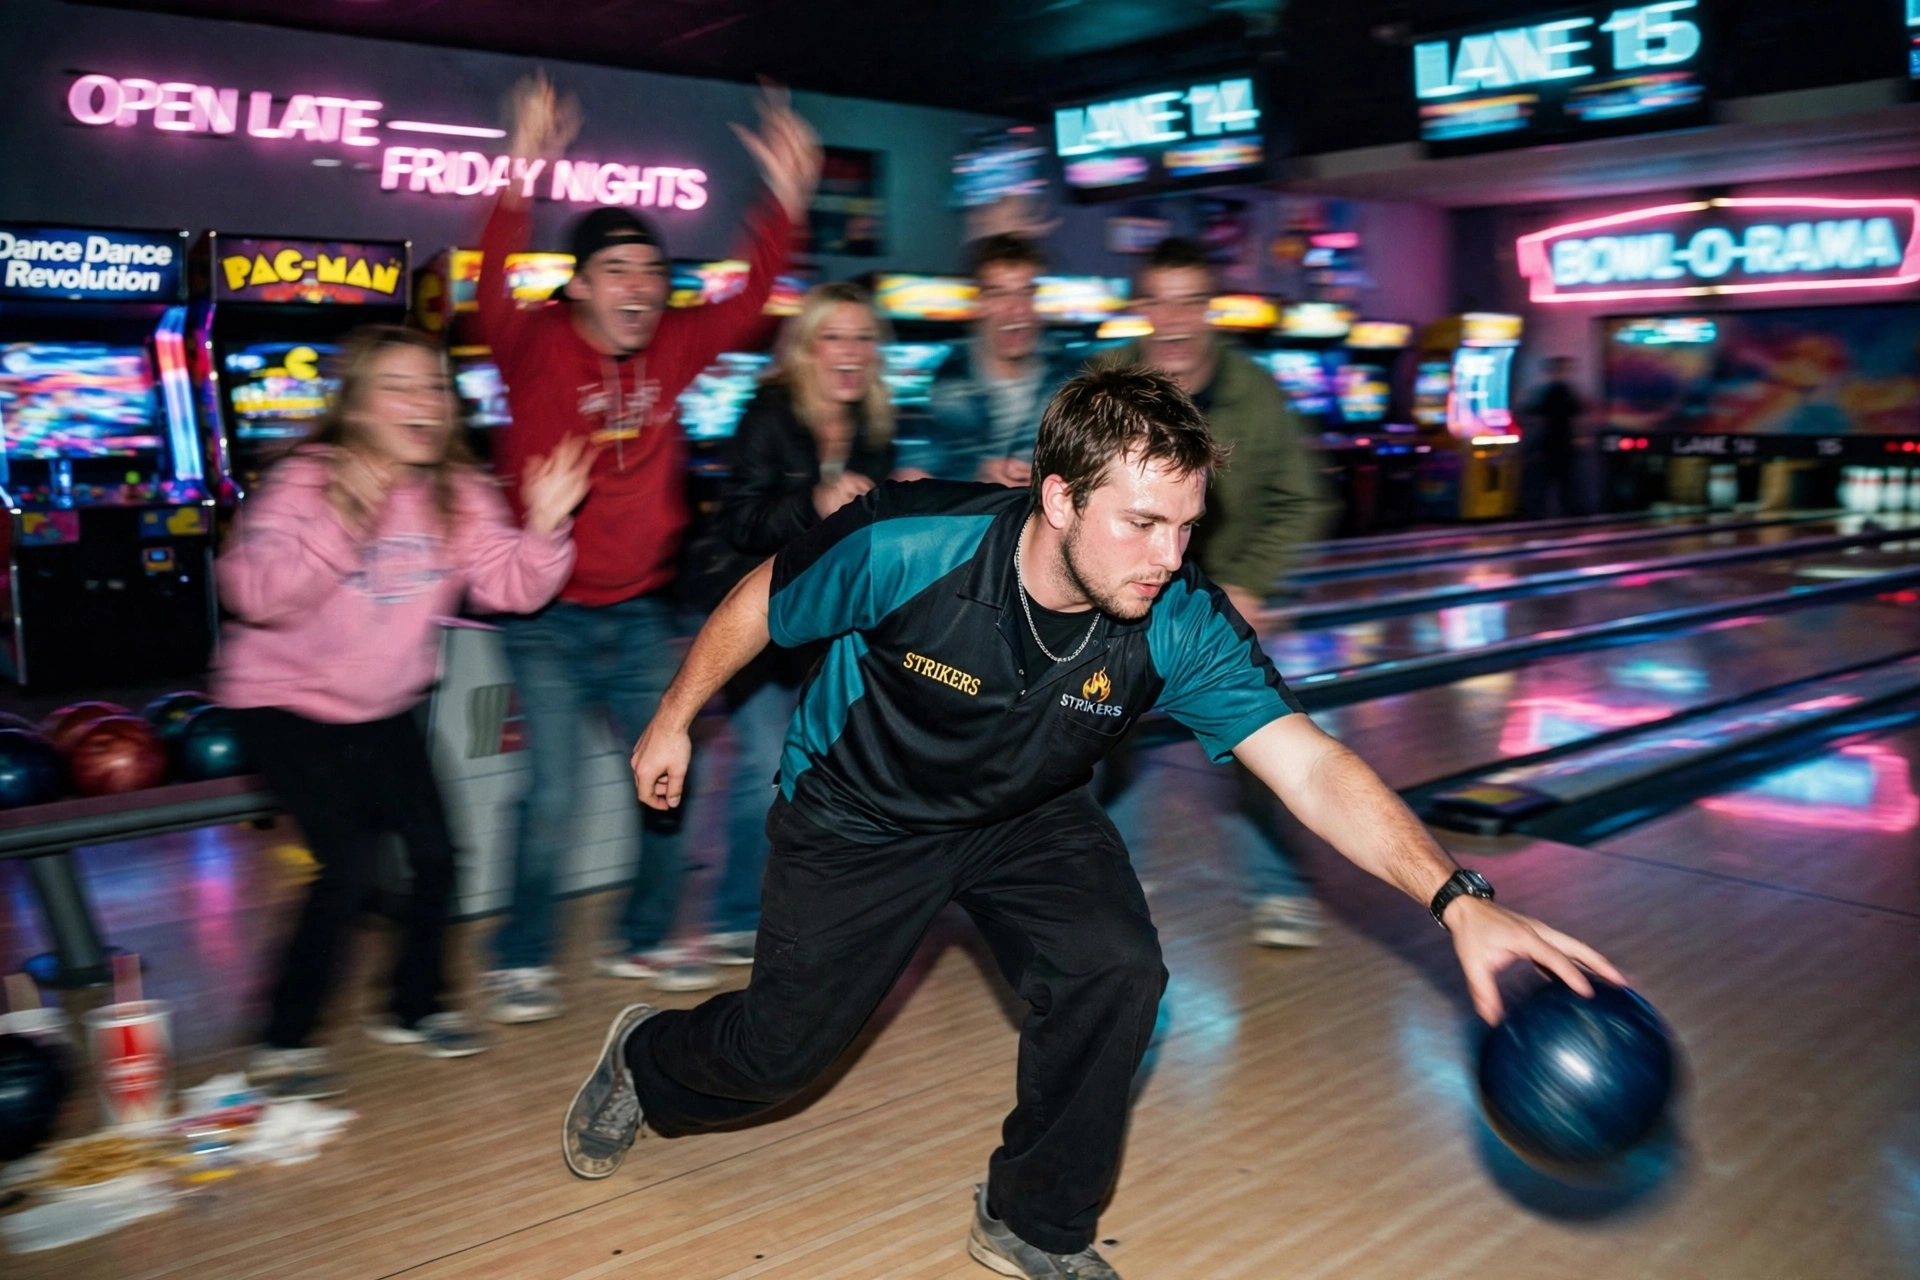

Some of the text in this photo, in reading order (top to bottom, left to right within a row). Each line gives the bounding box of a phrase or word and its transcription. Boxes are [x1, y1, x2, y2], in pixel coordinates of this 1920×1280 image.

[1413, 0, 1701, 99] LANE 15
[68, 74, 384, 147] OPEN LATE
[1055, 78, 1261, 157] LANE 14
[380, 146, 708, 211] FRIDAY NIGHTS
[0, 231, 173, 266] Dance Dance
[4, 259, 160, 292] Revolution
[222, 248, 401, 295] PAC-MAN
[1551, 217, 1901, 286] BOWL-O-RAMA
[903, 652, 981, 696] STRIKERS
[1060, 693, 1122, 717] STRIKERS
